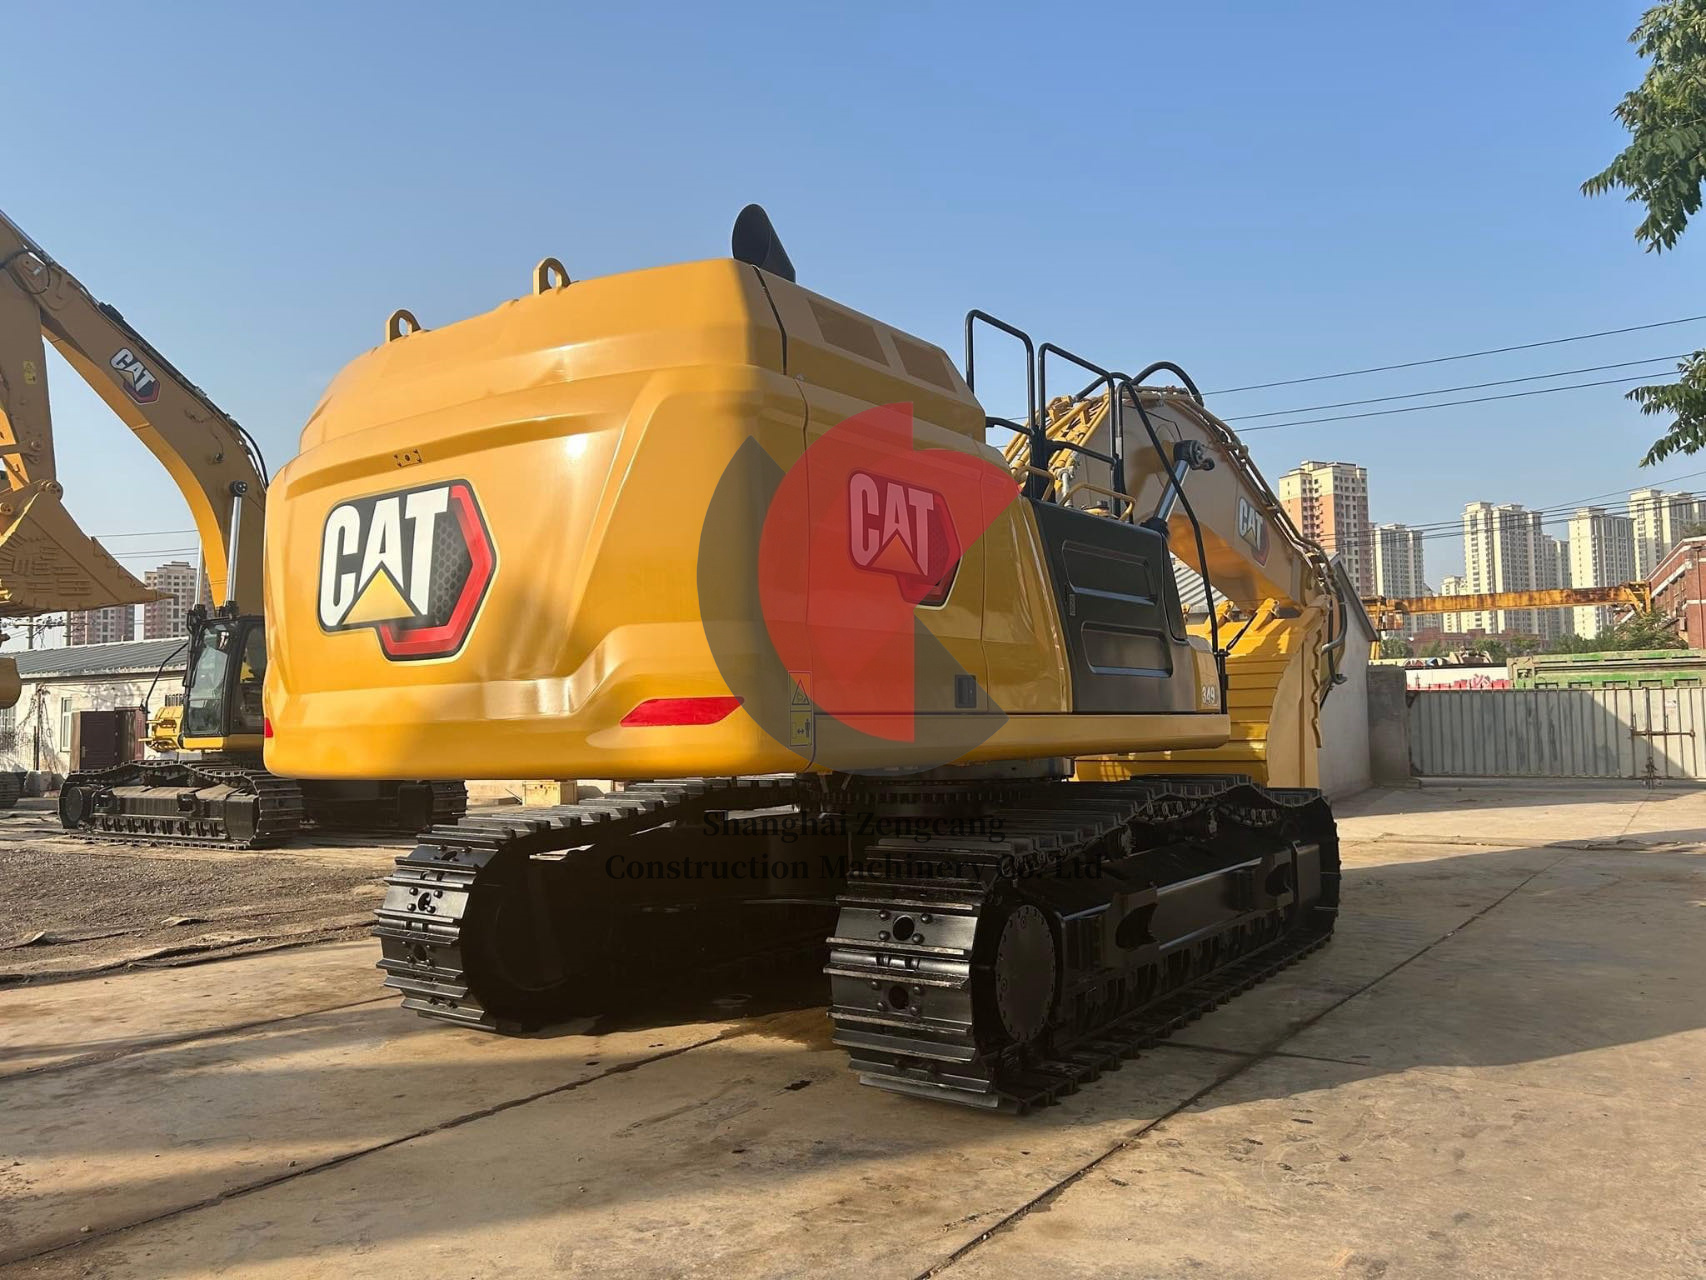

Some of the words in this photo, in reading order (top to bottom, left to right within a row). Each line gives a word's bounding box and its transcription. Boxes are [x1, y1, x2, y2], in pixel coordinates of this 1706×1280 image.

[111, 348, 156, 392] CAT
[850, 473, 934, 576] CAT
[1240, 498, 1263, 551] CAT
[320, 487, 449, 626] CAT
[1202, 686, 1215, 704] 349
